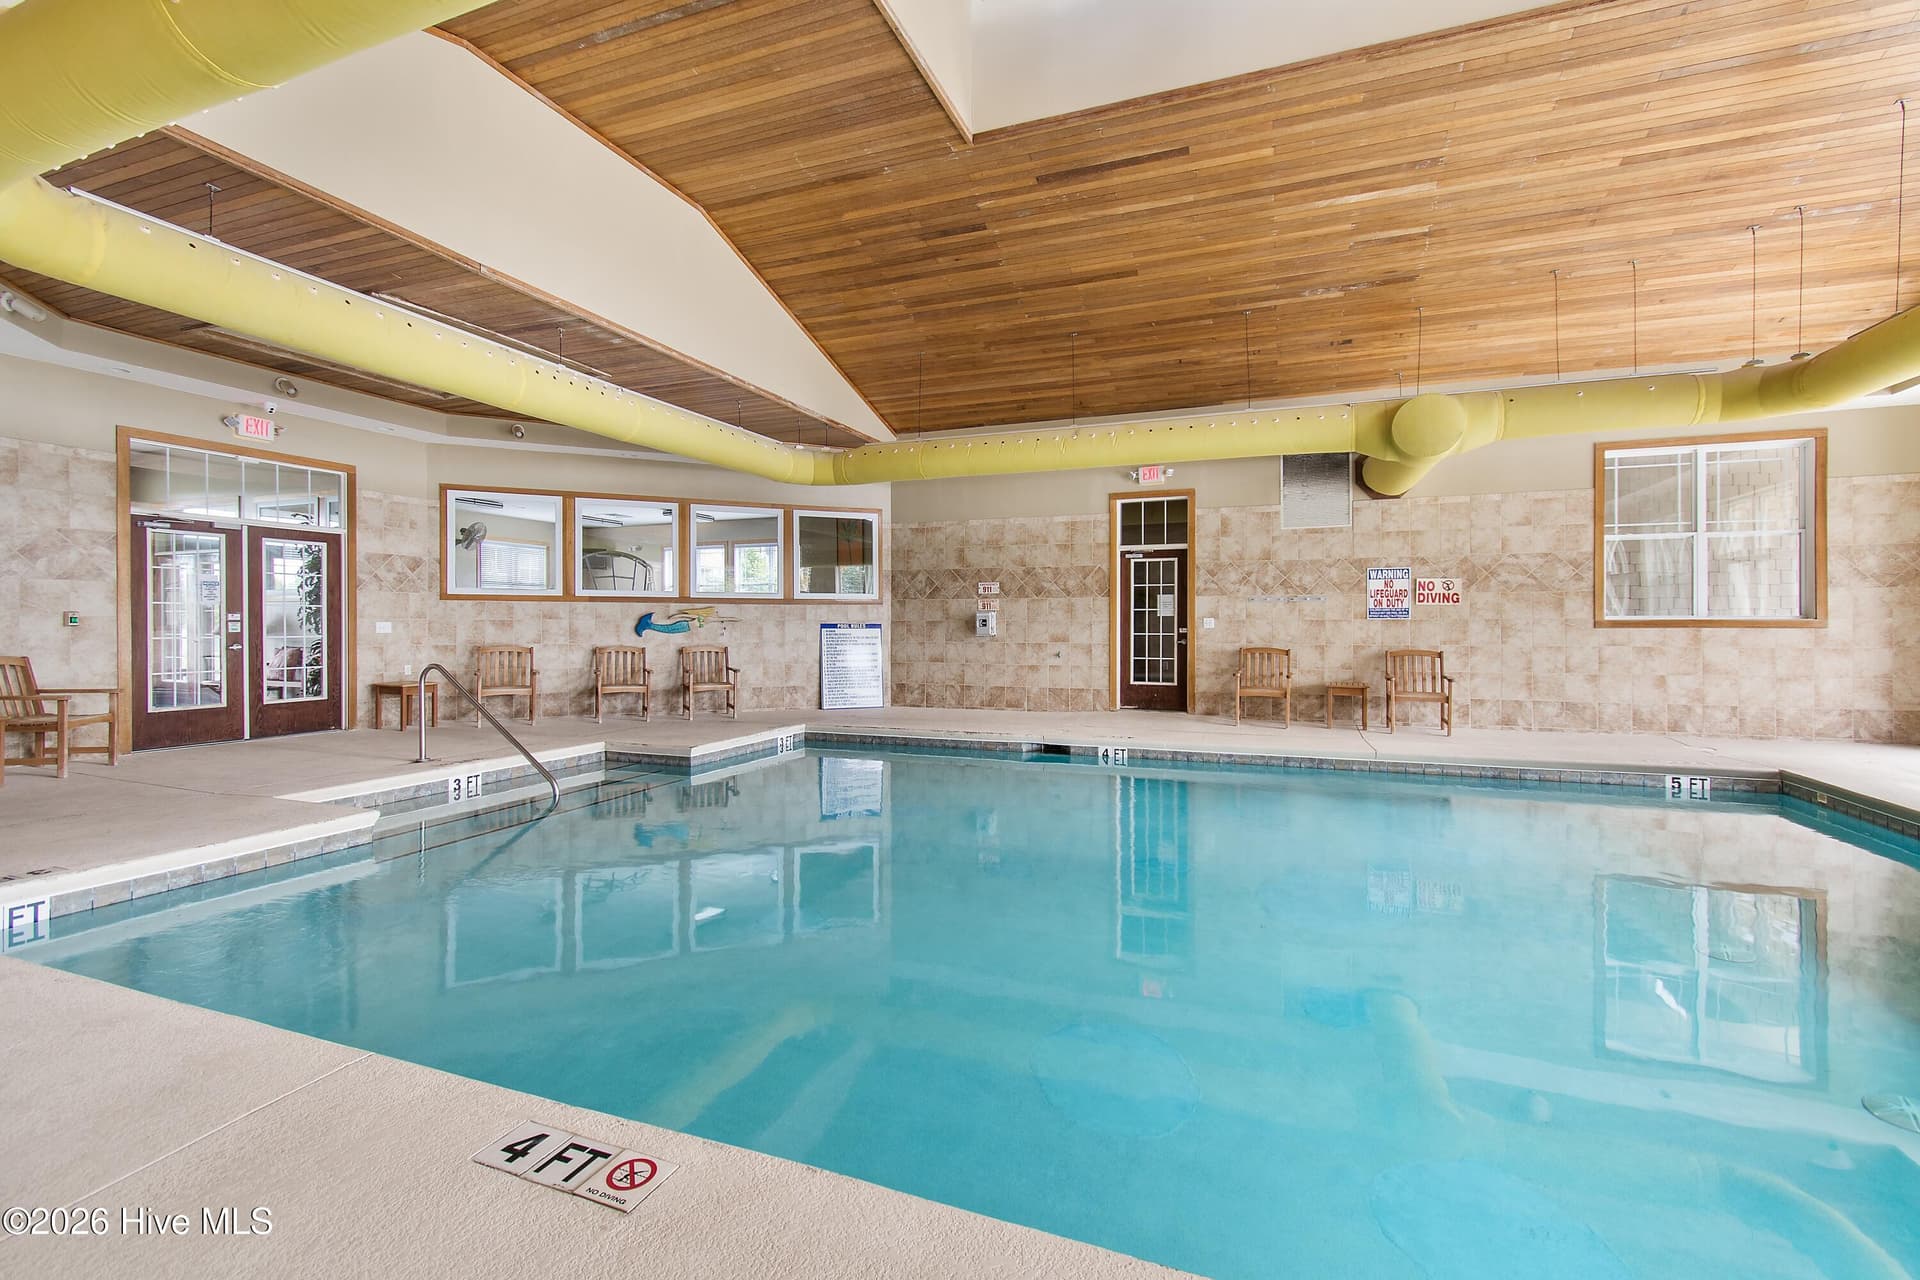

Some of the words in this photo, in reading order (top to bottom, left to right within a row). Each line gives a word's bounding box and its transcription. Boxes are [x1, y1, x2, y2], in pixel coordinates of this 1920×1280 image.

[245, 417, 271, 437] EXIT
[1142, 466, 1159, 480] EXIT
[1369, 569, 1409, 579] WARNING
[1384, 580, 1394, 589] NO
[1417, 581, 1435, 592] NO
[1369, 589, 1409, 599] LIFEGUARD
[1417, 592, 1460, 604] DIVING
[981, 602, 992, 610] 911
[1373, 598, 1383, 608] ON
[1386, 598, 1405, 608] DUTY
[453, 778, 461, 791] 3
[1671, 776, 1681, 789] 5
[1689, 777, 1708, 790] FT
[8, 900, 46, 929] FT
[501, 1133, 550, 1163] 4
[533, 1142, 613, 1183] FT
[586, 1186, 599, 1195] NO
[599, 1191, 627, 1205] DIVING
